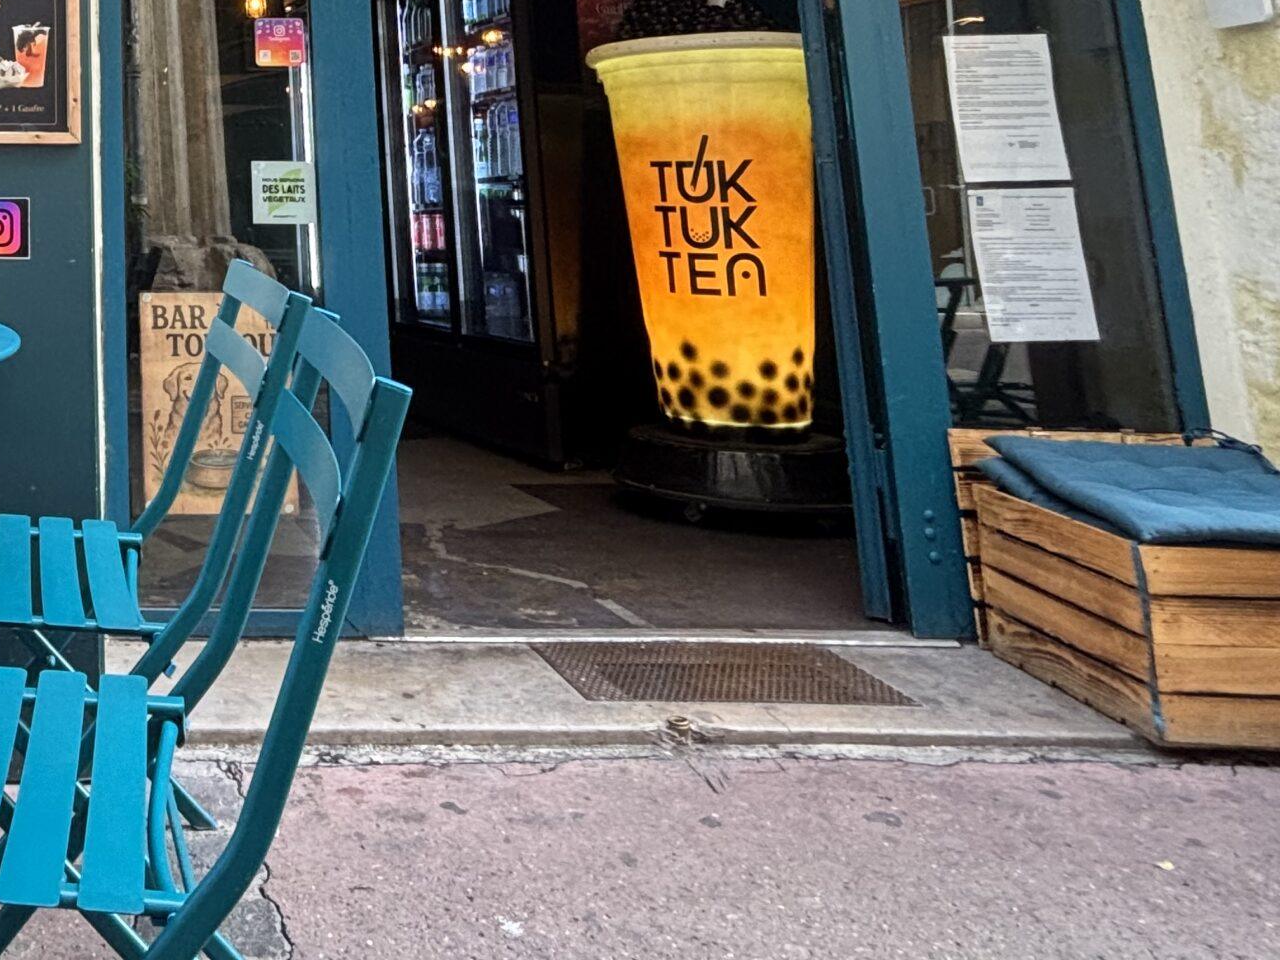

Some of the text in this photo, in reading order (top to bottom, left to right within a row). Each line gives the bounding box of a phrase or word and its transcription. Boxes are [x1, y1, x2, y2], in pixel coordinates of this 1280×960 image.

[262, 184, 306, 194] DES LAITS
[650, 134, 757, 204] TUK
[654, 206, 761, 249] TUK
[658, 251, 767, 297] TEA
[151, 305, 208, 330] BAR
